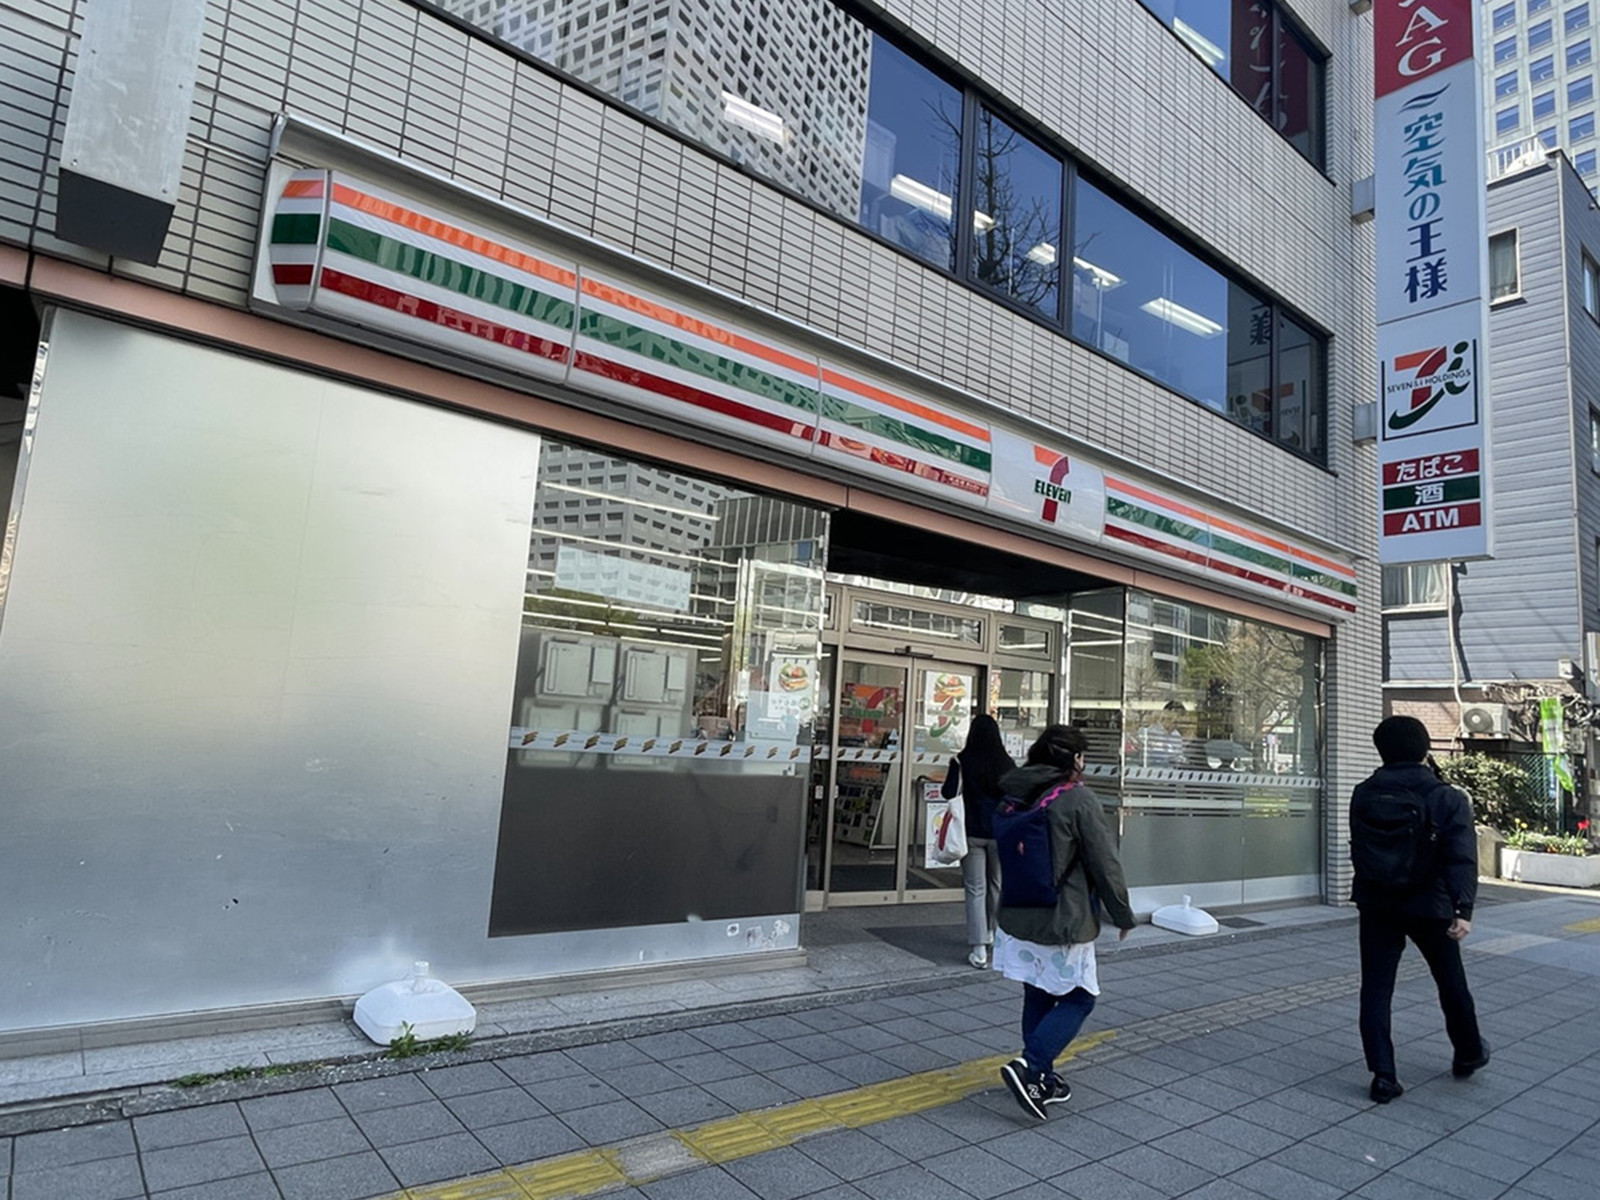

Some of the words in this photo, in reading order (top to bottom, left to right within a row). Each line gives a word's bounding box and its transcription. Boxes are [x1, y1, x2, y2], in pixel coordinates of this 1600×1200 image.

[1402, 111, 1448, 303] 空気の王様
[1387, 381, 1413, 394] SEVEN
[1424, 368, 1472, 386] HOLDINGS
[1396, 455, 1464, 482] たばこ
[1415, 482, 1445, 505] 酒
[1401, 507, 1460, 532] ATM
